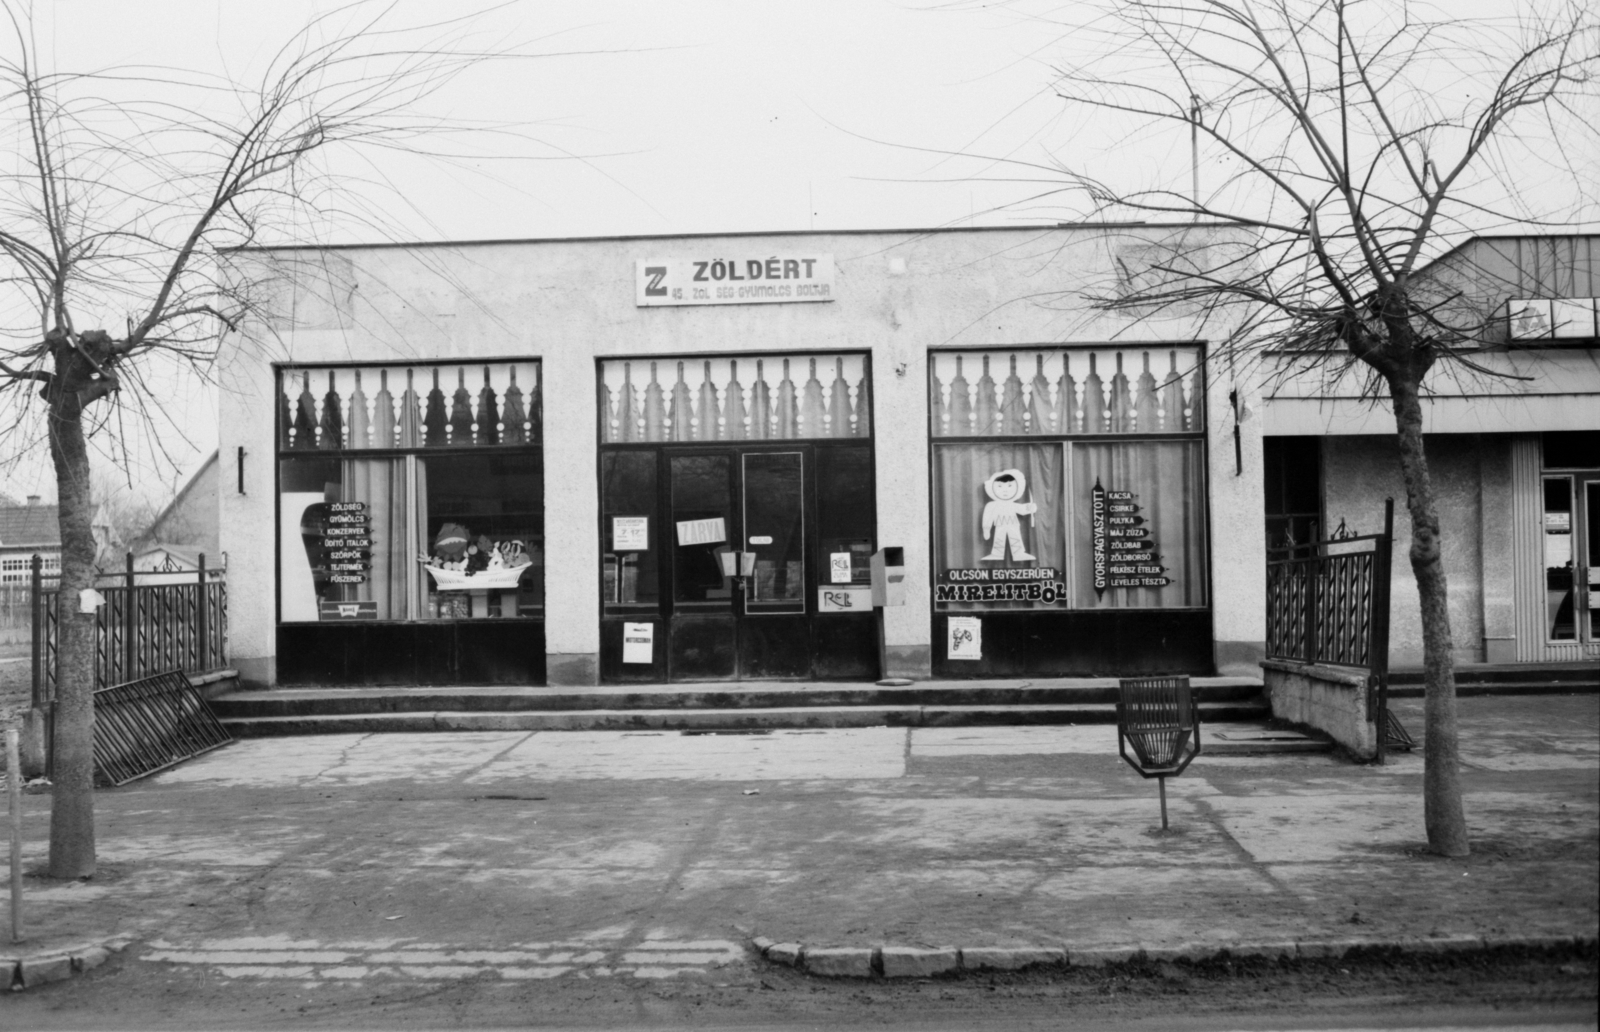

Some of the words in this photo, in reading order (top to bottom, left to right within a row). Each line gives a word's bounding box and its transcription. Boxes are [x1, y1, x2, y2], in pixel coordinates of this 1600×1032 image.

[692, 256, 817, 281] ZÖLDÉRT
[1108, 492, 1132, 500] KACSA
[1109, 504, 1135, 512] CSIRKE
[327, 527, 366, 535] KONZERVEK
[1109, 528, 1124, 537] MÁJ
[346, 538, 369, 547] ITALOK
[1093, 489, 1106, 588] GYORSFAGYASZTOTT
[1110, 541, 1142, 550] ZÖLDBAB
[1137, 565, 1161, 574] ÉTELEK
[1110, 578, 1140, 587] LEVELES
[1141, 576, 1167, 586] TÉSZTA
